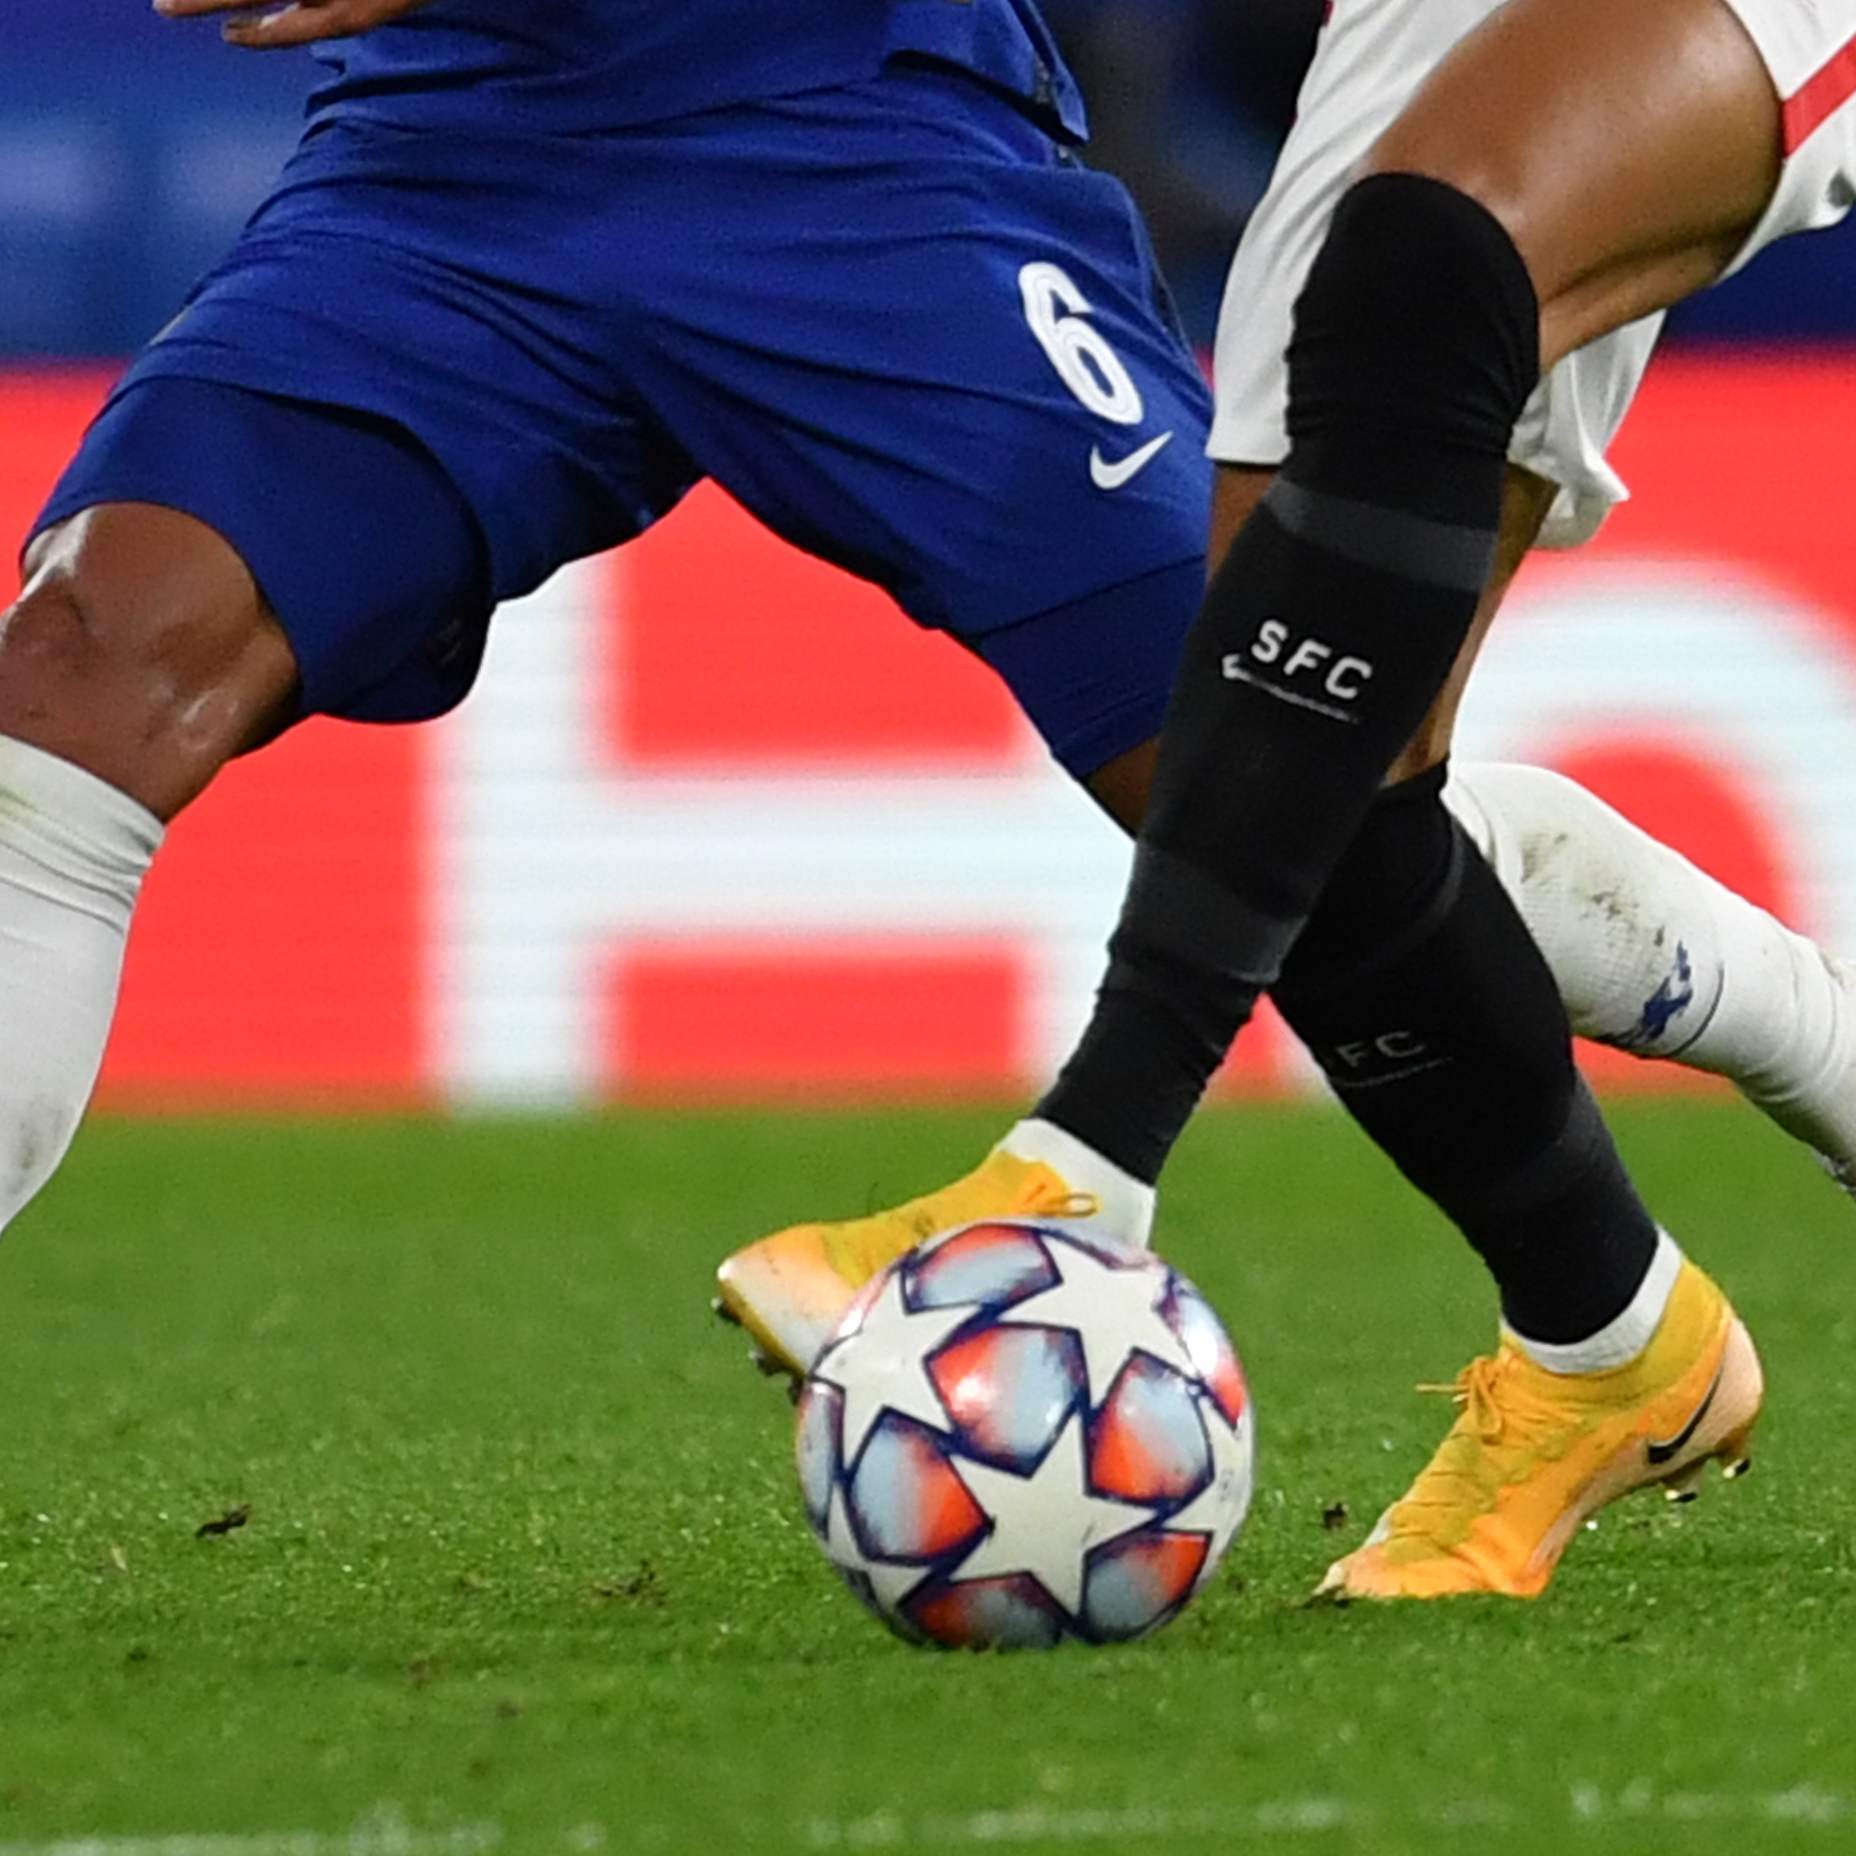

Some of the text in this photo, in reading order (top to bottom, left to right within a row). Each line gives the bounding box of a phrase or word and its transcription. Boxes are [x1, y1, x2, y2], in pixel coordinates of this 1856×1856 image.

[1017, 260, 1144, 425] 6
[1250, 619, 1373, 700] SFC
[1326, 1030, 1426, 1069] FC
